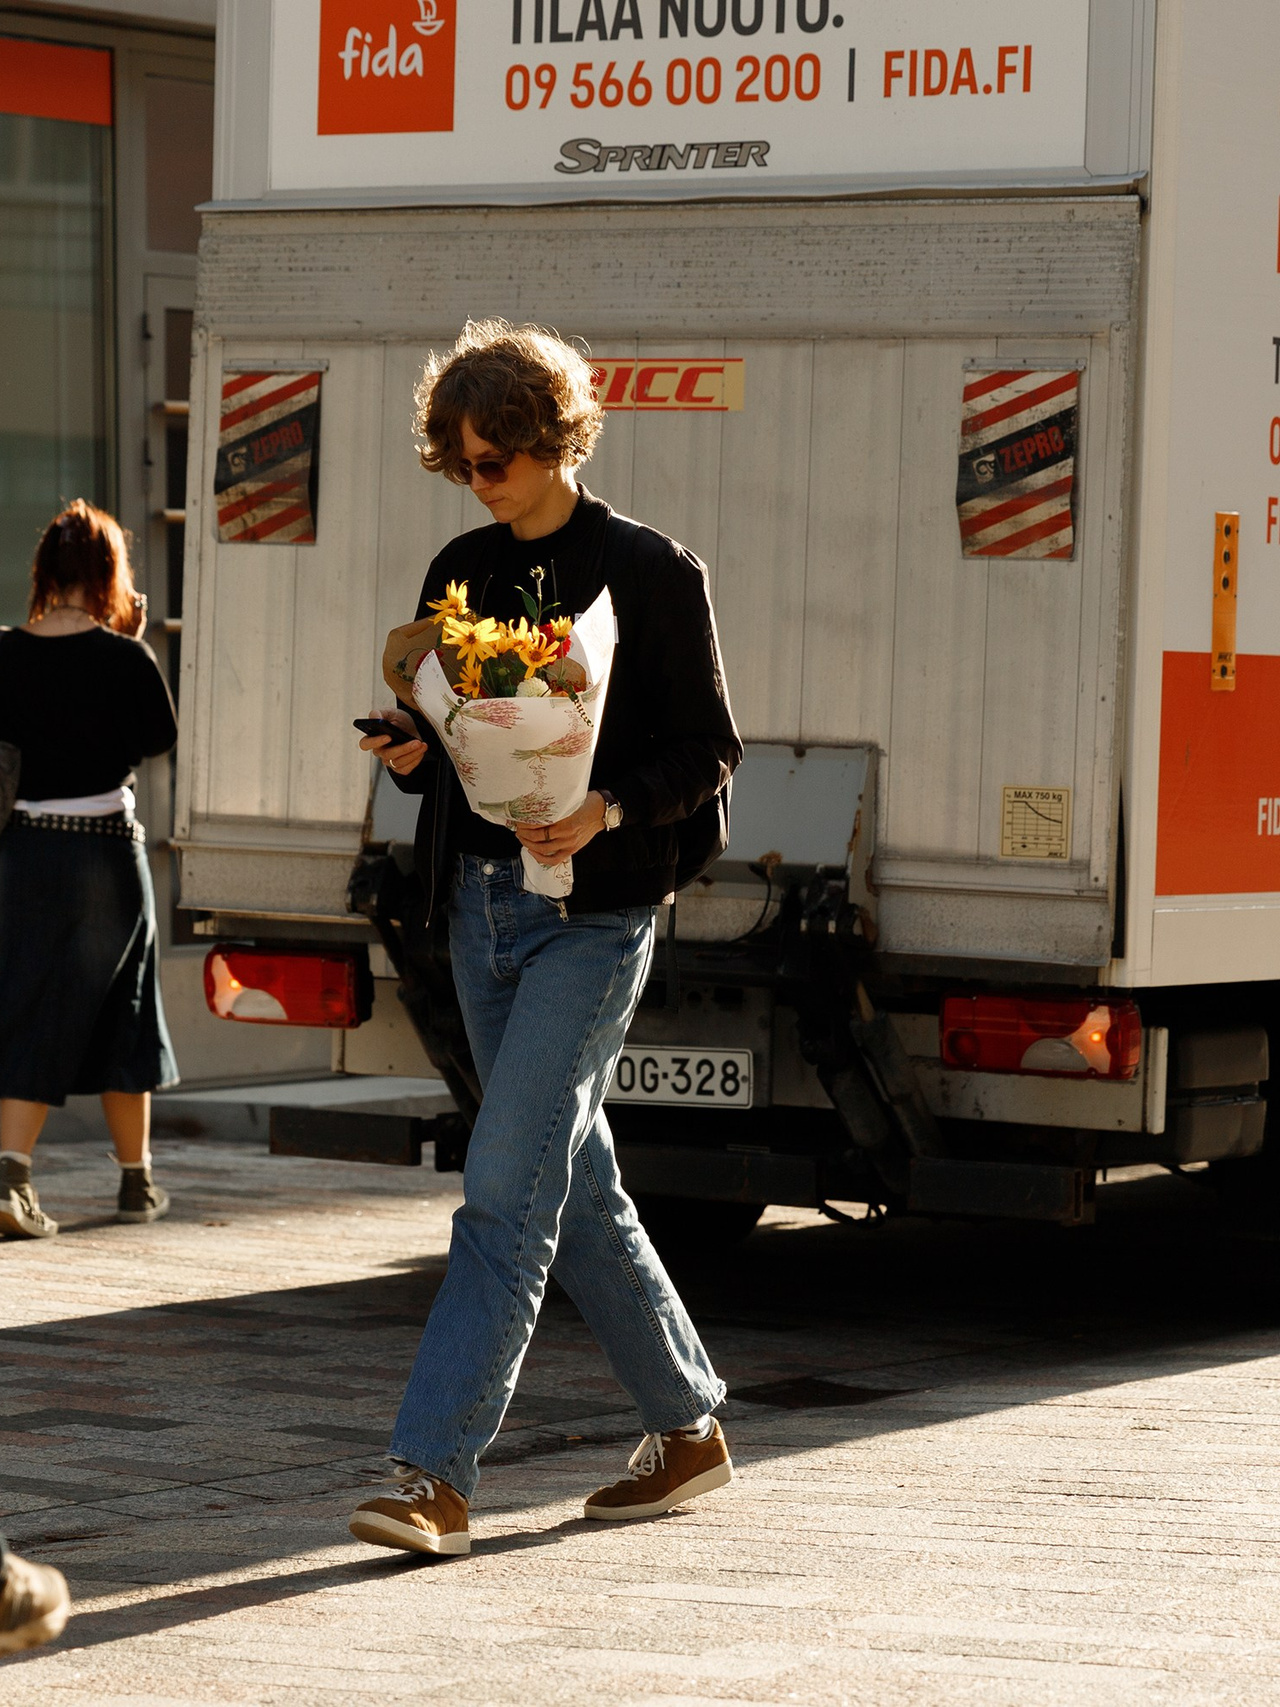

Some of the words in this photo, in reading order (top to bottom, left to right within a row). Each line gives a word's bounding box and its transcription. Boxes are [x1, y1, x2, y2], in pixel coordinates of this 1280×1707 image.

[338, 23, 424, 81] fida
[505, 63, 557, 111] 09
[570, 60, 653, 109] 566
[666, 56, 721, 106] 00
[735, 53, 821, 103] 200
[883, 45, 1032, 98] FIDA.FI
[554, 138, 770, 174] SPRINTER
[249, 420, 305, 464] ZEPRO
[999, 426, 1066, 474] ZEPRO
[1014, 790, 1033, 800] MAX
[1035, 791, 1051, 801] 750
[1052, 792, 1063, 803] kg
[617, 1055, 741, 1097] OG-328
